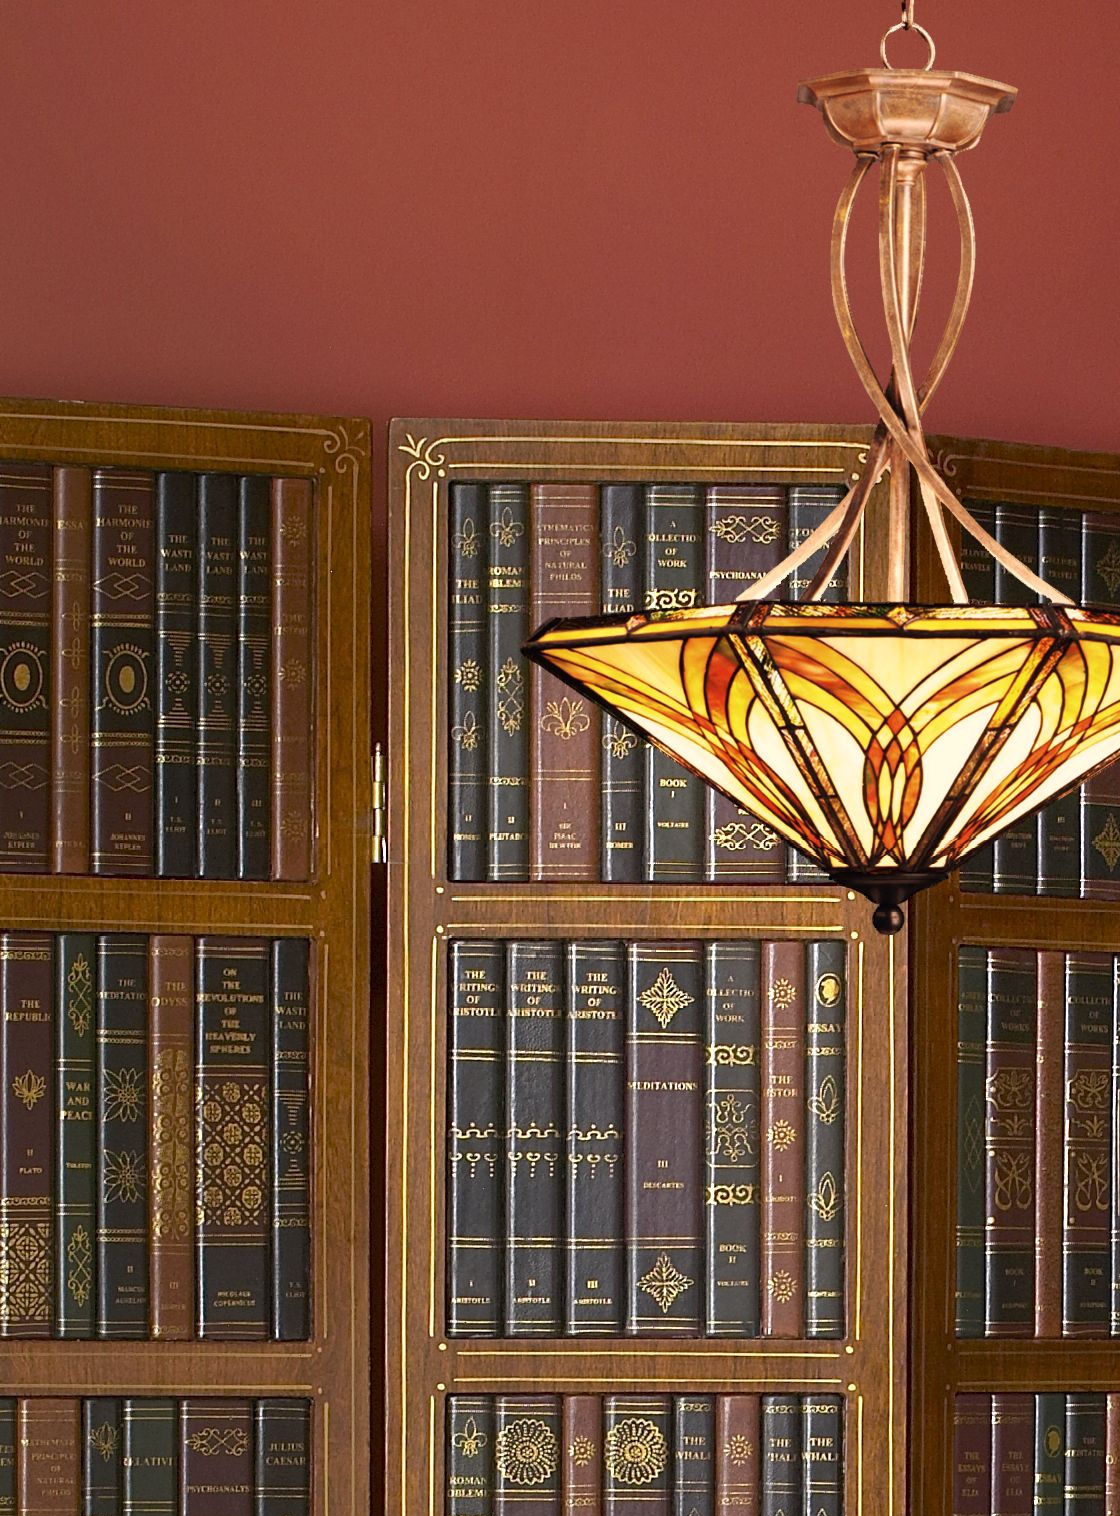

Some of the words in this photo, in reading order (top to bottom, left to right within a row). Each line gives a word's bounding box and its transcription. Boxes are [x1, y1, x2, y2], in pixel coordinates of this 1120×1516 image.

[118, 505, 138, 514] THE
[117, 545, 138, 554] THE
[665, 548, 677, 556] OF
[6, 556, 44, 566] WORLD
[108, 557, 146, 568] WORLD
[658, 559, 687, 568] WORK
[456, 580, 479, 589] THE
[608, 589, 630, 598] THE
[603, 604, 634, 613] ILIAD
[660, 779, 687, 788] BOOK
[465, 971, 485, 979] THE
[526, 972, 547, 980] THE
[587, 973, 608, 981] THE
[22, 1000, 40, 1008] THE
[772, 1076, 793, 1084] THE
[683, 1436, 705, 1445] THE
[810, 1437, 833, 1447] THE
[270, 1443, 304, 1451] JULIUS
[266, 1457, 305, 1466] CAESAR
